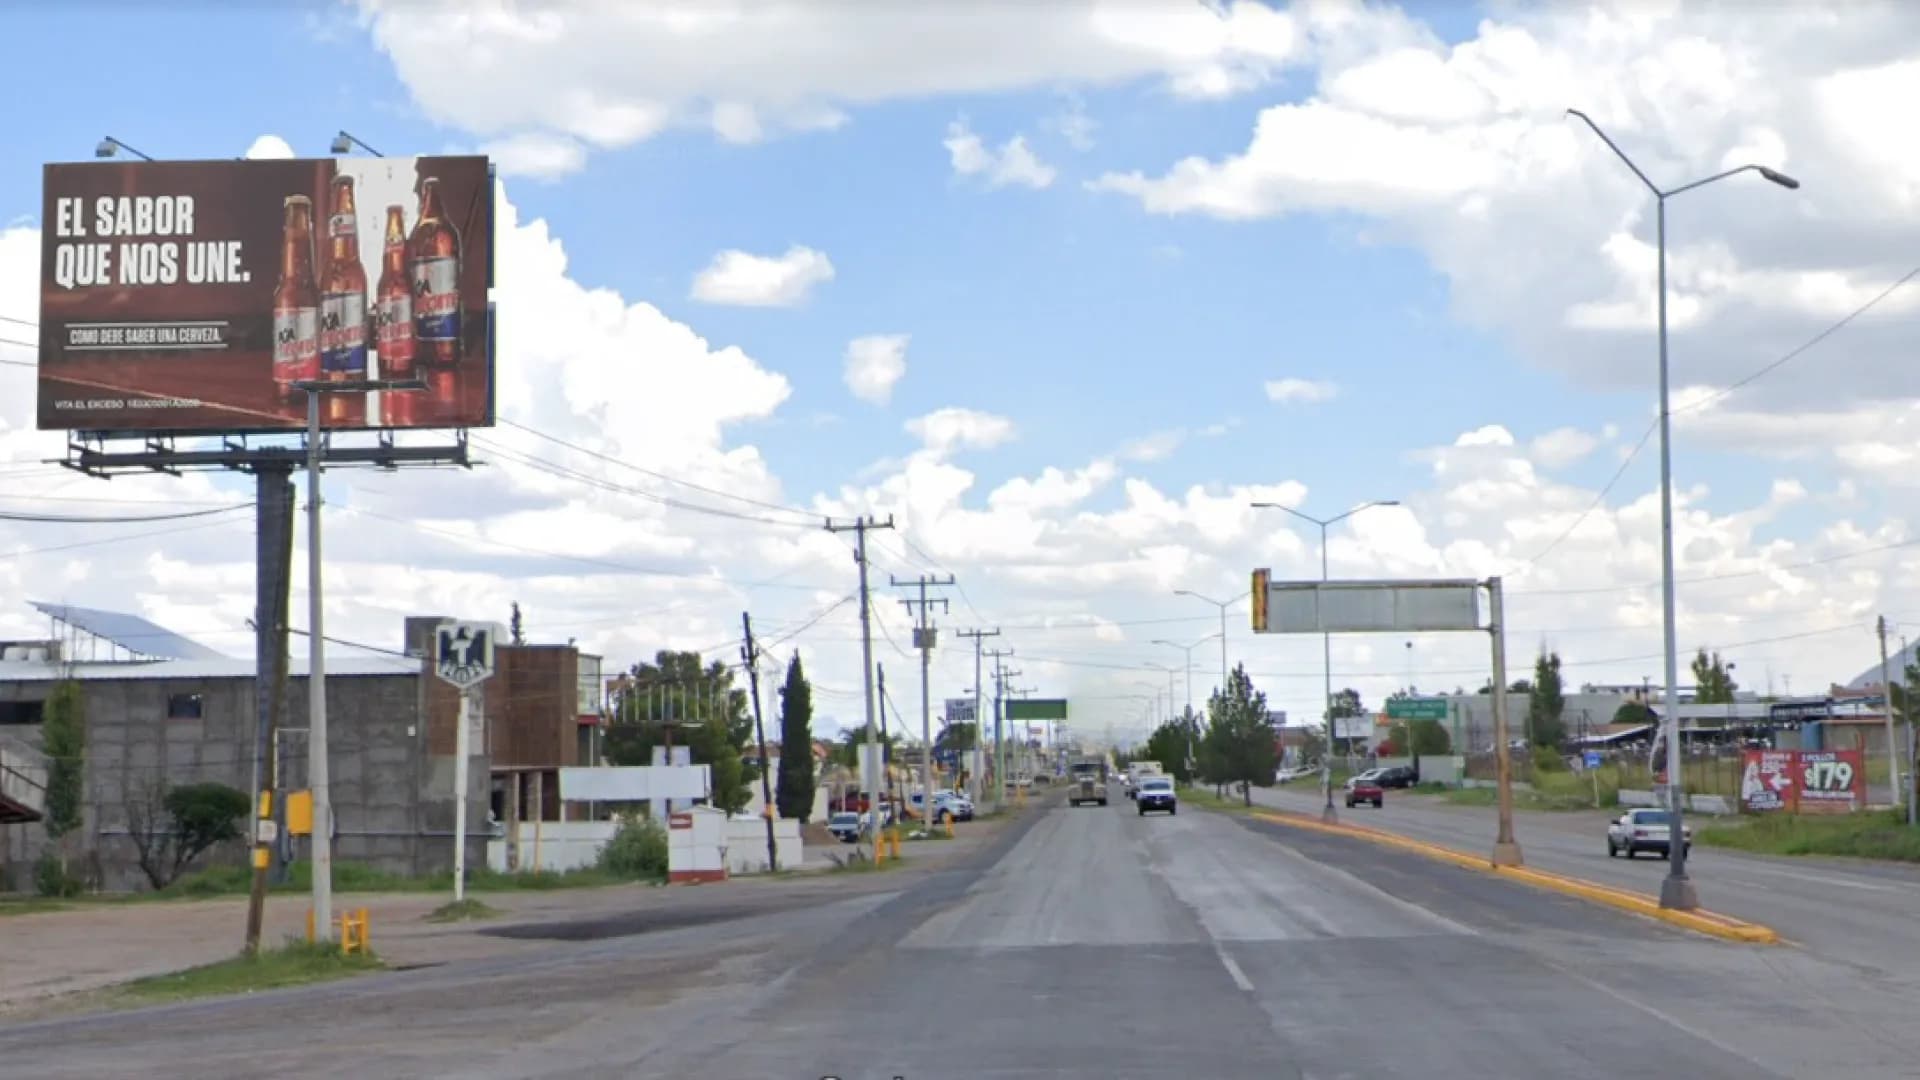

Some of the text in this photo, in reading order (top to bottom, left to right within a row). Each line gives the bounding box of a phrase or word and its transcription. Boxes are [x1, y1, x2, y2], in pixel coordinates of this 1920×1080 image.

[56, 195, 195, 237] EL SABOR
[55, 240, 251, 290] QUE NOS UNE.
[69, 329, 99, 344] COMO
[101, 328, 125, 344] DEBE
[126, 328, 156, 343] SABER
[157, 327, 178, 343] UNA
[87, 400, 125, 409] EXCESO
[1804, 761, 1853, 790] $179
